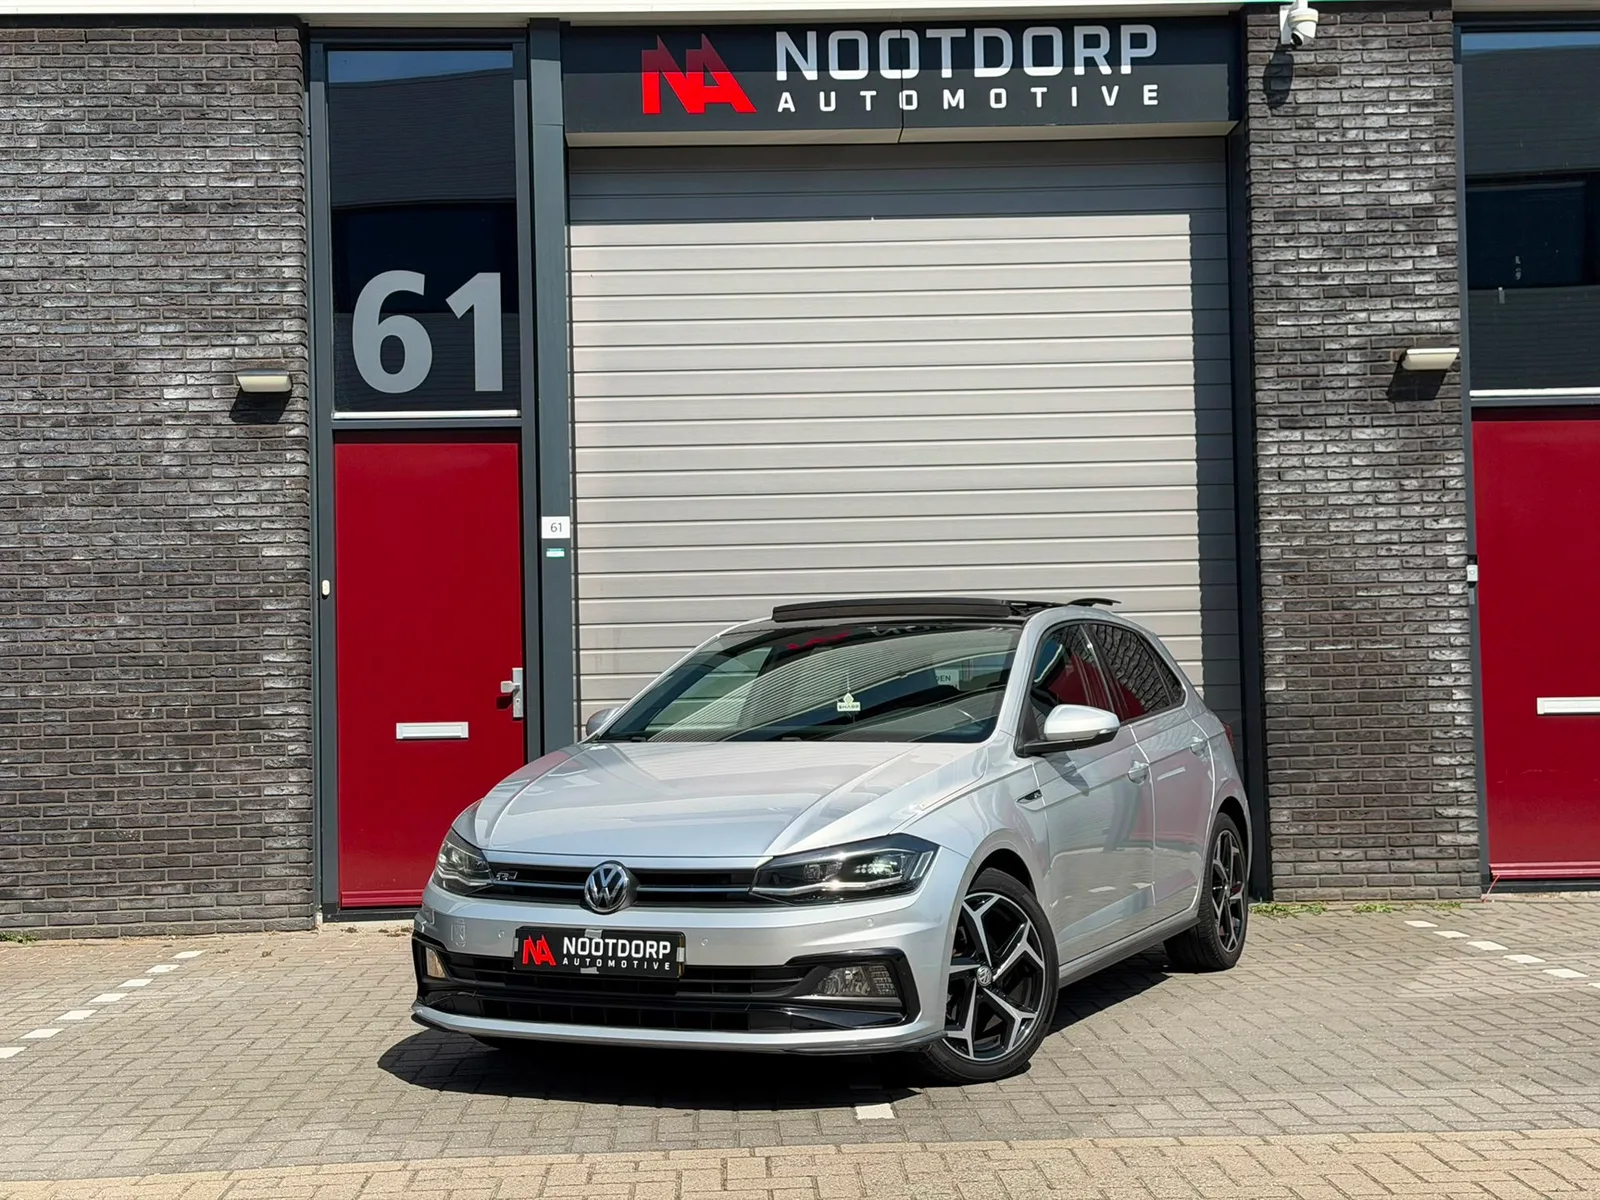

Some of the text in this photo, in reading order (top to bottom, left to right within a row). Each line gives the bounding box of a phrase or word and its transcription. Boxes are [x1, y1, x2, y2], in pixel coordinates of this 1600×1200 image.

[775, 24, 1158, 81] NOOTDORP
[777, 84, 1159, 113] AUTOMOTIVE
[352, 269, 503, 394] 61
[550, 521, 562, 533] 61
[562, 936, 671, 959] NOOTDORP
[562, 957, 670, 971] AUTOMOTIVE
